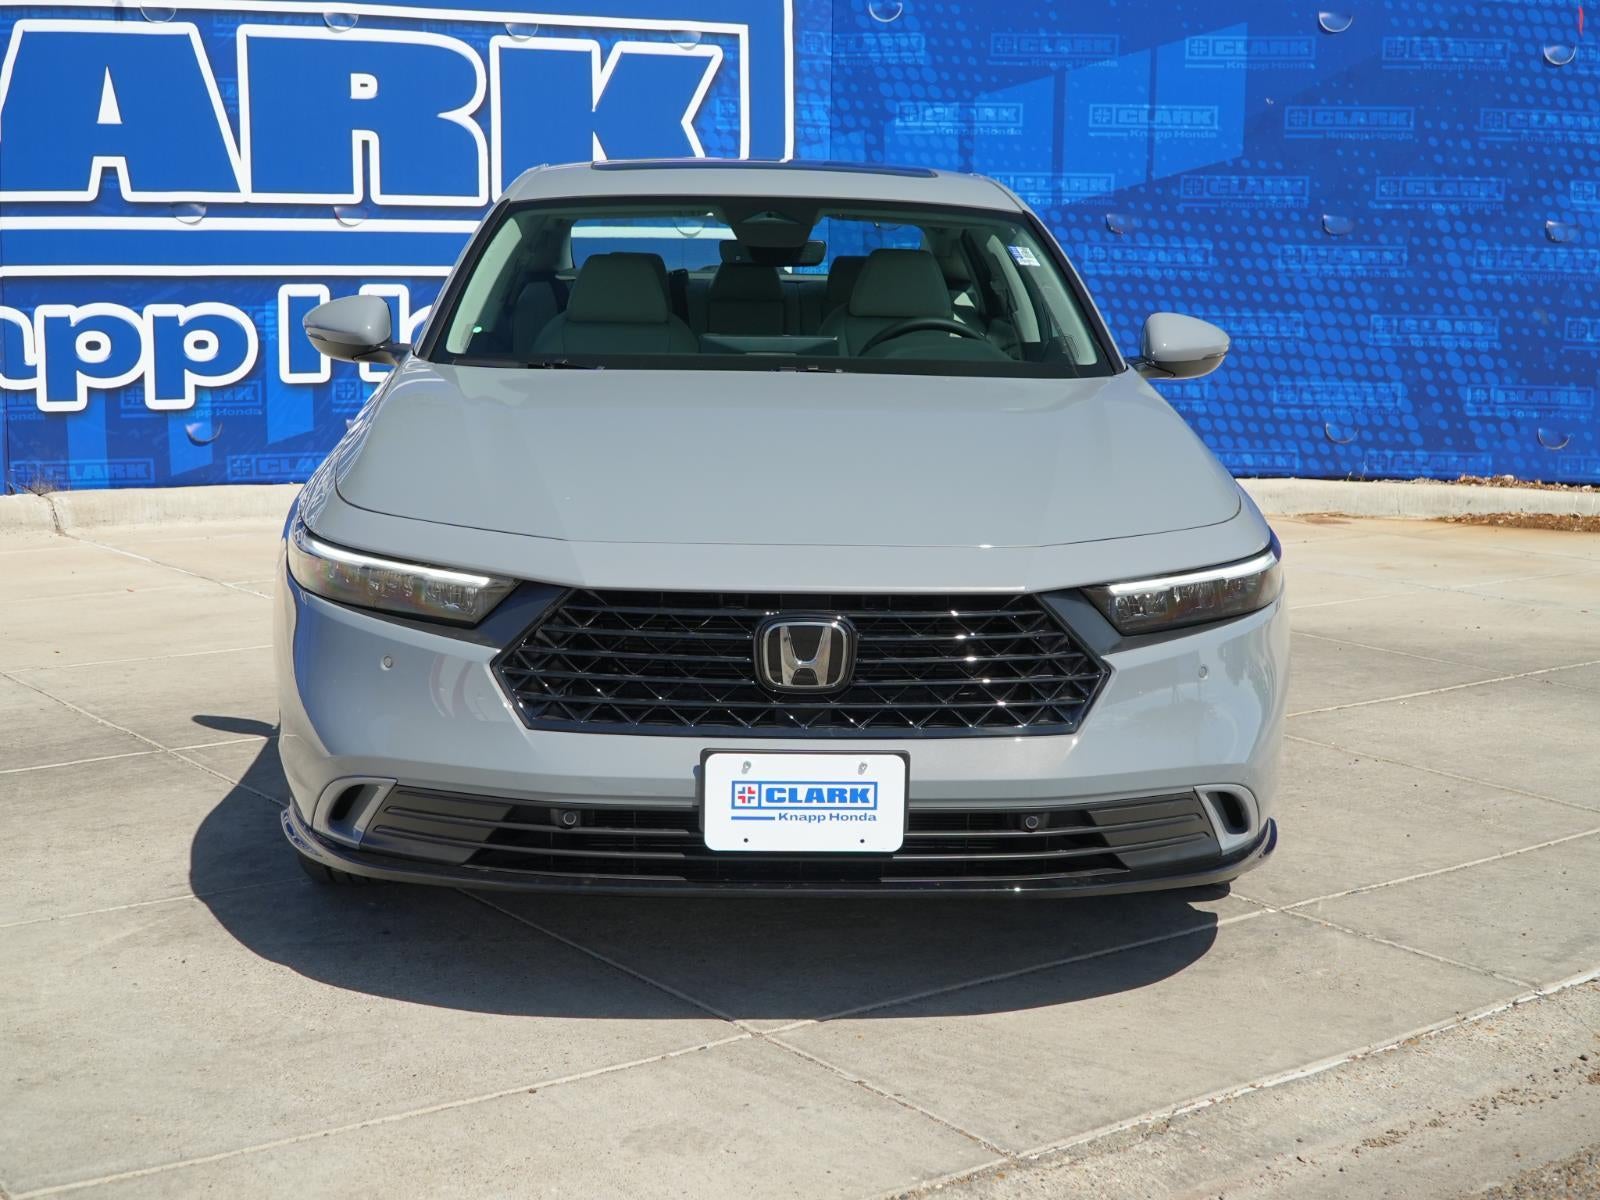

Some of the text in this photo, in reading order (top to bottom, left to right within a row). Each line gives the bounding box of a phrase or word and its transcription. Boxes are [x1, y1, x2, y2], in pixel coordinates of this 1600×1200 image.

[1019, 37, 1113, 52] CLARK
[1214, 39, 1310, 55] CLARK
[924, 106, 1017, 122] CLARK
[1117, 108, 1213, 125] CLARK
[1314, 110, 1409, 126] CLARK
[1208, 179, 1304, 194] CLARK
[43, 463, 148, 479] CLARK
[765, 787, 871, 804] CLARK
[778, 812, 877, 823] Knapp Honda
